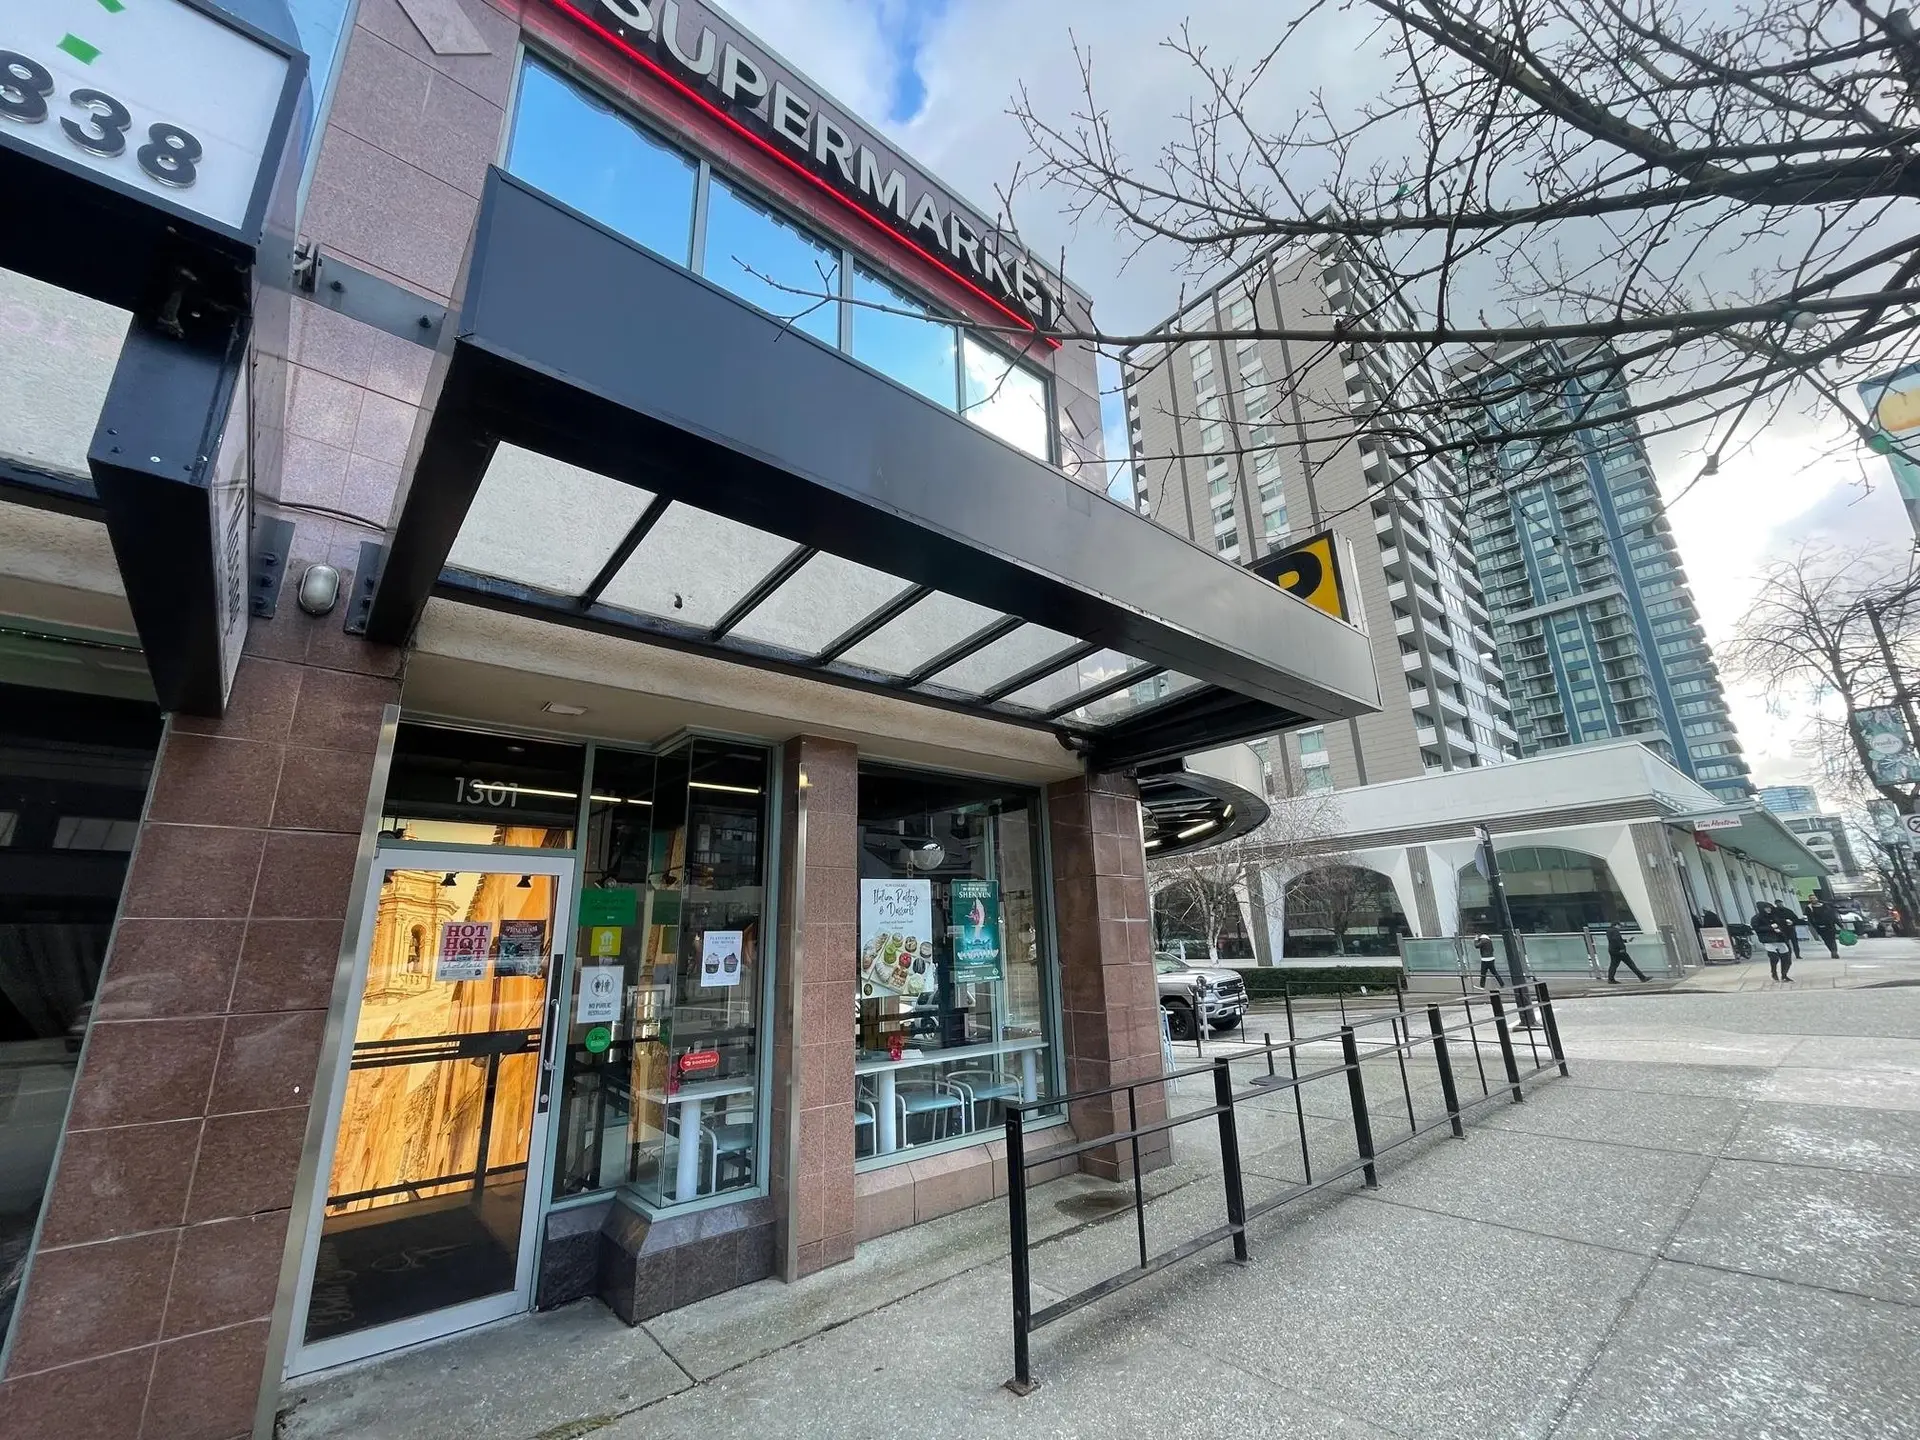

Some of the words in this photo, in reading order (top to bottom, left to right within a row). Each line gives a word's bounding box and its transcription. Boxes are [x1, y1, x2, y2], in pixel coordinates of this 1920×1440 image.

[0, 49, 202, 188] 838
[455, 777, 519, 808] 1301
[958, 891, 977, 899] SHEN
[977, 891, 992, 899] YUN
[446, 925, 489, 937] HOT
[444, 937, 487, 950] HOT
